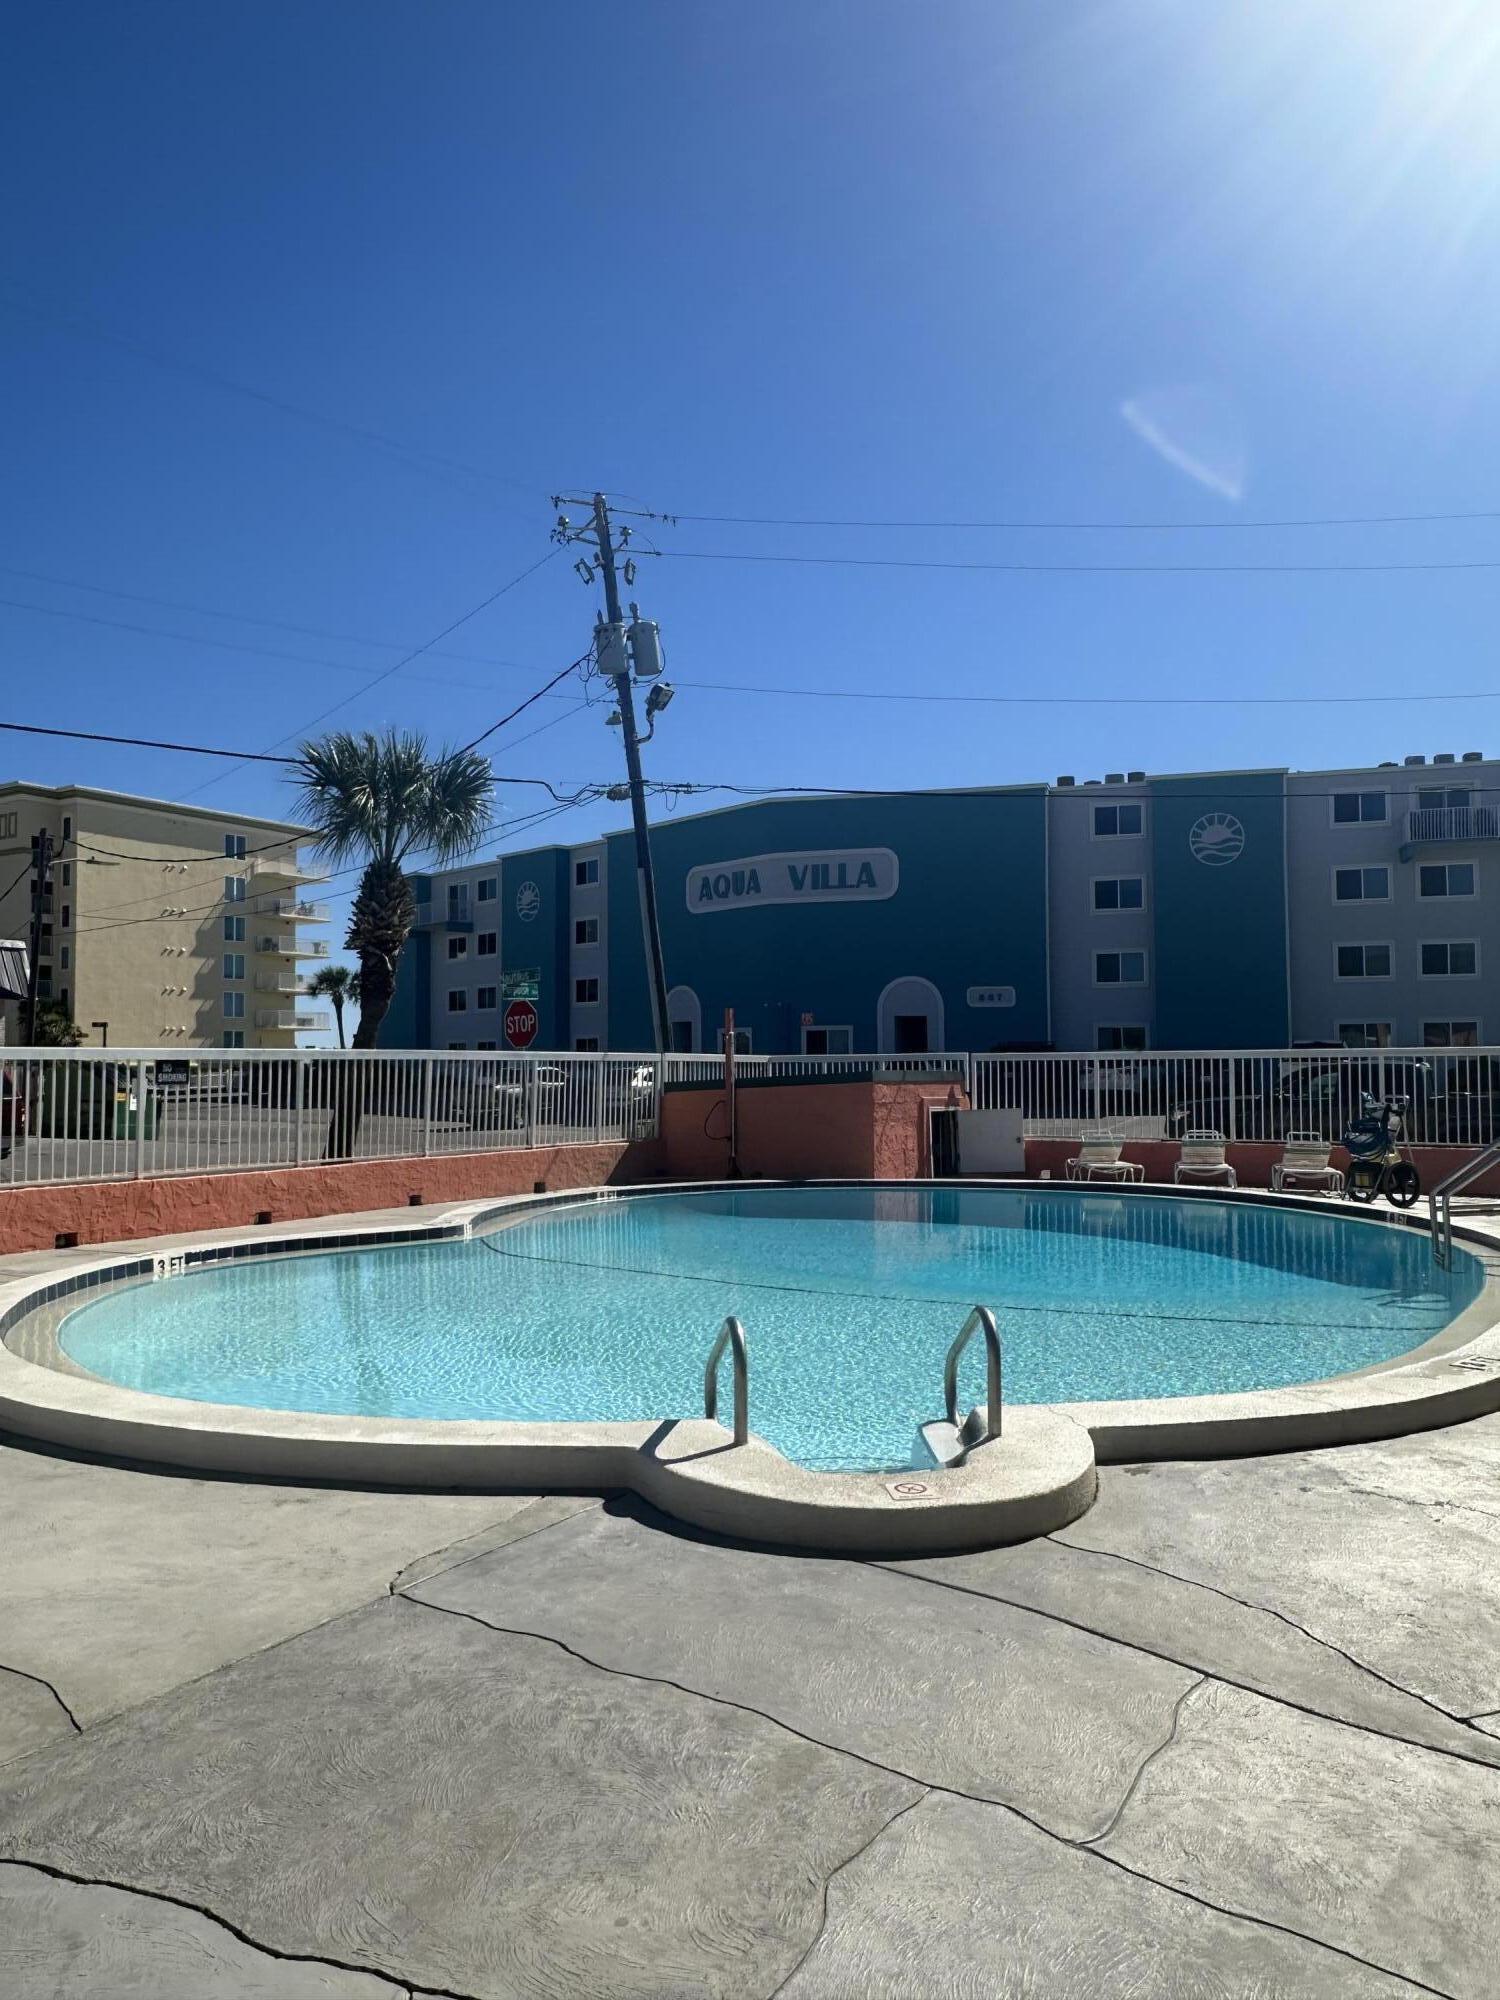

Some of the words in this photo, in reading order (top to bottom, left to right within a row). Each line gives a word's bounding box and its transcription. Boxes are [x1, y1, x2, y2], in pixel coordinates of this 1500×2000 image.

[698, 868, 762, 902] AQUA
[787, 862, 877, 892] VILLA
[507, 1014, 535, 1034] STOP
[170, 1255, 184, 1270] FT
